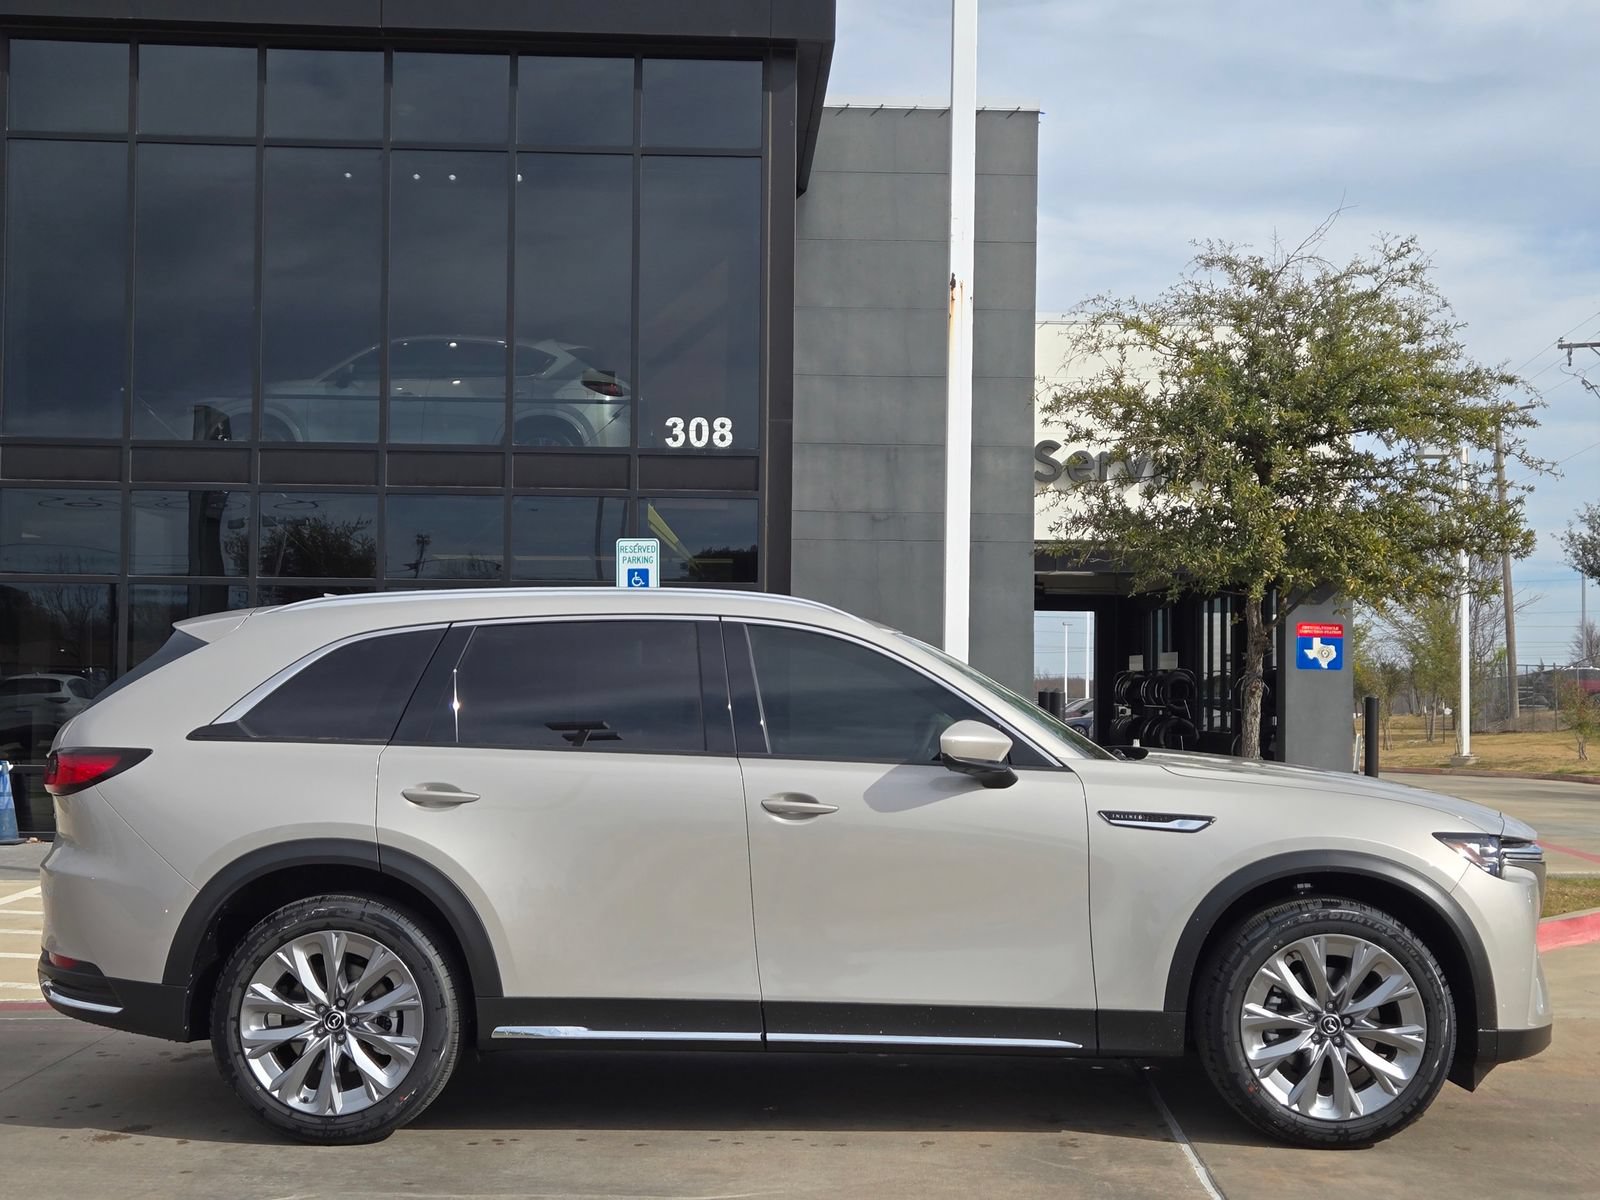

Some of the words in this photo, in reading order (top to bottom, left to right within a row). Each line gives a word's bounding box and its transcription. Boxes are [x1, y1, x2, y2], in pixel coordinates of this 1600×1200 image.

[665, 417, 733, 448] 308
[1034, 439, 1176, 483] Serv
[620, 545, 656, 553] RESERVED
[622, 556, 654, 564] PARKING
